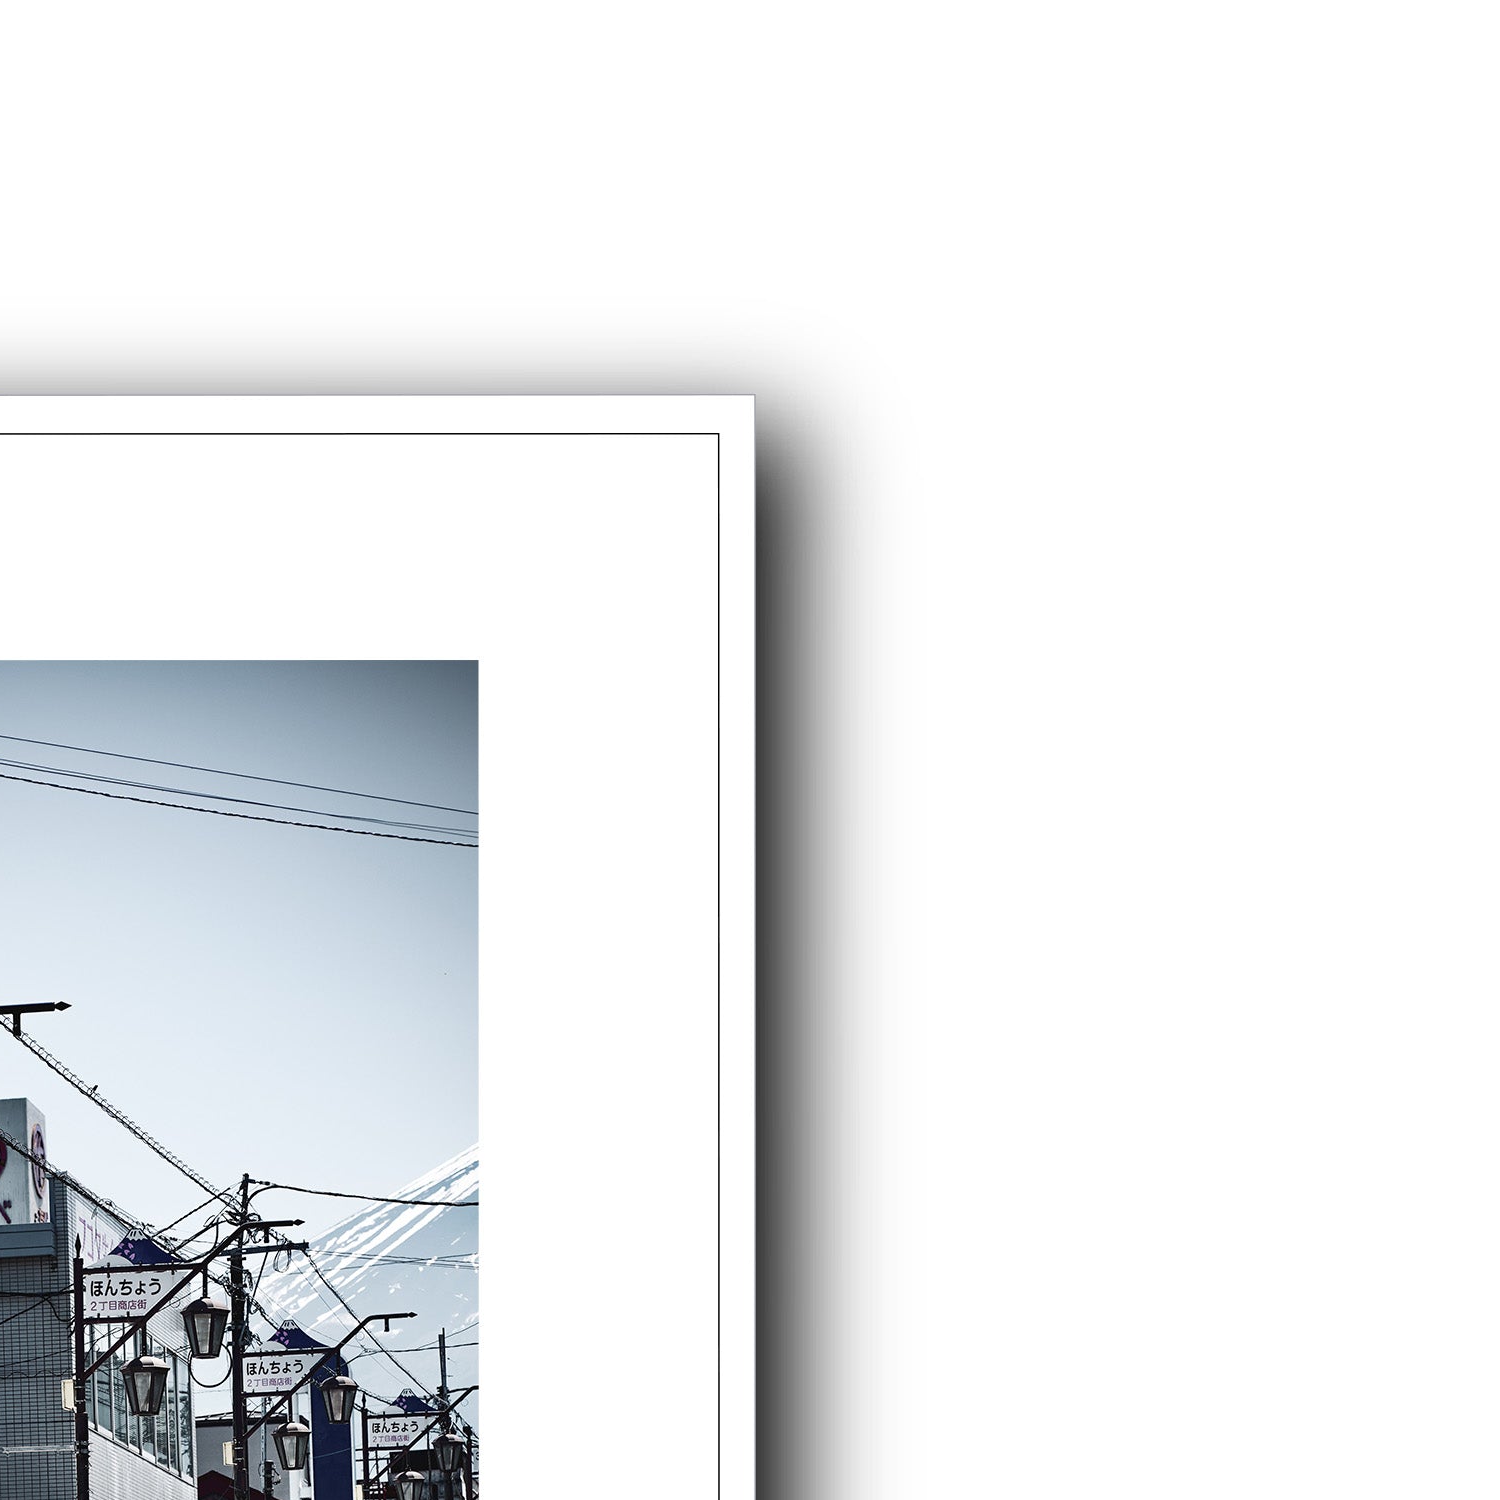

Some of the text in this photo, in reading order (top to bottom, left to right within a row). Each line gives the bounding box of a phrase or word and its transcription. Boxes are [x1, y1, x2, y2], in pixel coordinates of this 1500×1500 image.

[90, 1278, 161, 1297] ほんちょう
[90, 1299, 147, 1311] 2丁目商店街
[246, 1359, 303, 1375] ほんちょう
[372, 1421, 419, 1434] ほんちょう
